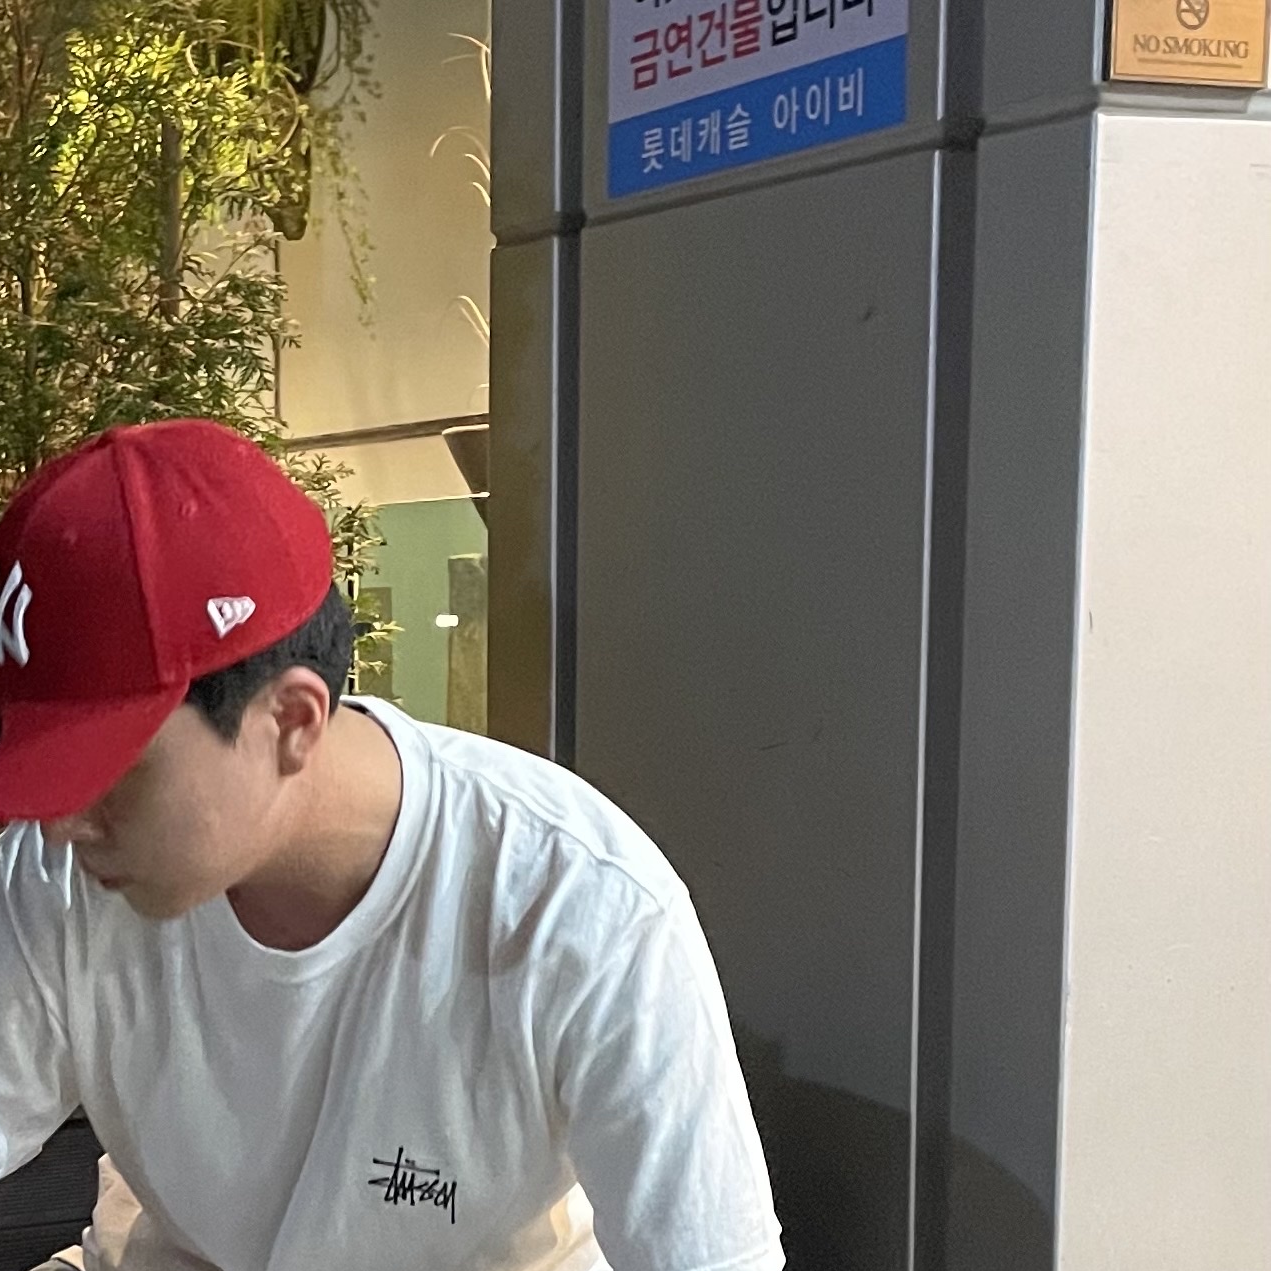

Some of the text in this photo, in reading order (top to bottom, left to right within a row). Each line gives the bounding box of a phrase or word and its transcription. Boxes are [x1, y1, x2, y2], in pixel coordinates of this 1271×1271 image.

[1133, 34, 1249, 59] NO SMOKING
[641, 67, 864, 174] 롯데캐슬 아이비
